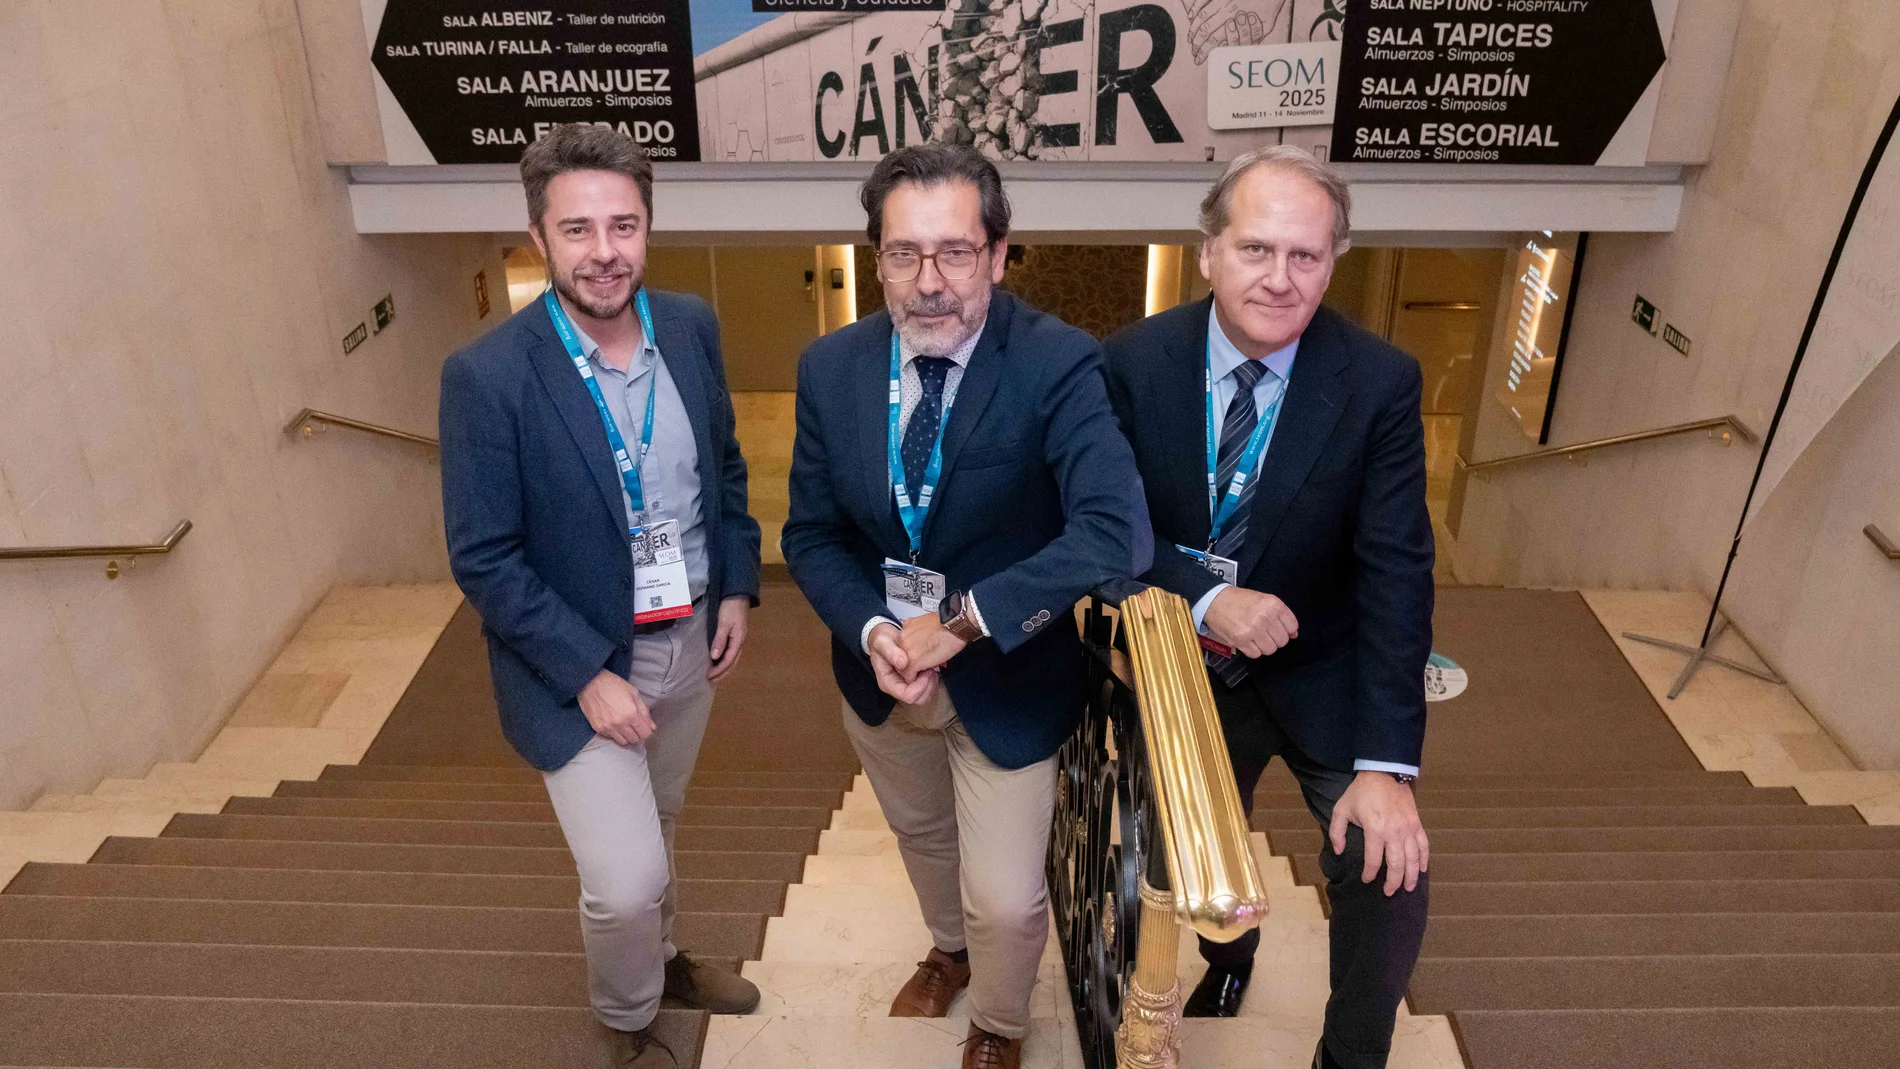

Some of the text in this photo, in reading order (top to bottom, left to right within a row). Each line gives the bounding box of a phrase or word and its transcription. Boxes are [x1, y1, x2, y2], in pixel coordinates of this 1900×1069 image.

[1370, 0, 1404, 10] SALA
[1410, 0, 1492, 11] NEPTUNO
[1507, 0, 1588, 13] HOSPITALITY
[443, 15, 477, 28] SALA
[481, 11, 553, 27] ALBENIZ
[566, 13, 597, 25] Taller
[600, 13, 614, 25] de
[618, 12, 666, 25] nutrición
[1366, 22, 1553, 48] SALA TAPICES
[386, 44, 420, 57] SALA
[423, 40, 486, 56] TURINA
[488, 40, 495, 54] /
[498, 39, 552, 55] FALLA
[565, 42, 596, 54] Taller
[598, 42, 613, 53] de
[615, 41, 668, 55] ecografía
[1364, 47, 1434, 61] Almuerzos
[1447, 48, 1515, 64] Simposios
[457, 68, 671, 95] SALA ARANJUEZ
[1228, 57, 1325, 90] SEOM
[1361, 67, 1530, 97] SALA JARDÍN
[525, 95, 593, 108] Almuerzos
[605, 93, 673, 109] Simposios
[1279, 88, 1325, 107] 2025
[1358, 96, 1428, 110] Almuerzos
[1440, 97, 1507, 113] Simposios
[1286, 108, 1325, 117] Noviembre
[471, 128, 527, 145] SALA
[574, 120, 675, 144] ADO
[1355, 122, 1560, 147] SALA ESCORIAL
[643, 144, 677, 158] osios
[1352, 146, 1421, 160] Almuerzos
[1433, 147, 1499, 163] Simposios
[1664, 326, 1690, 353] SALIDA
[1249, 415, 1272, 455] www.seom.org
